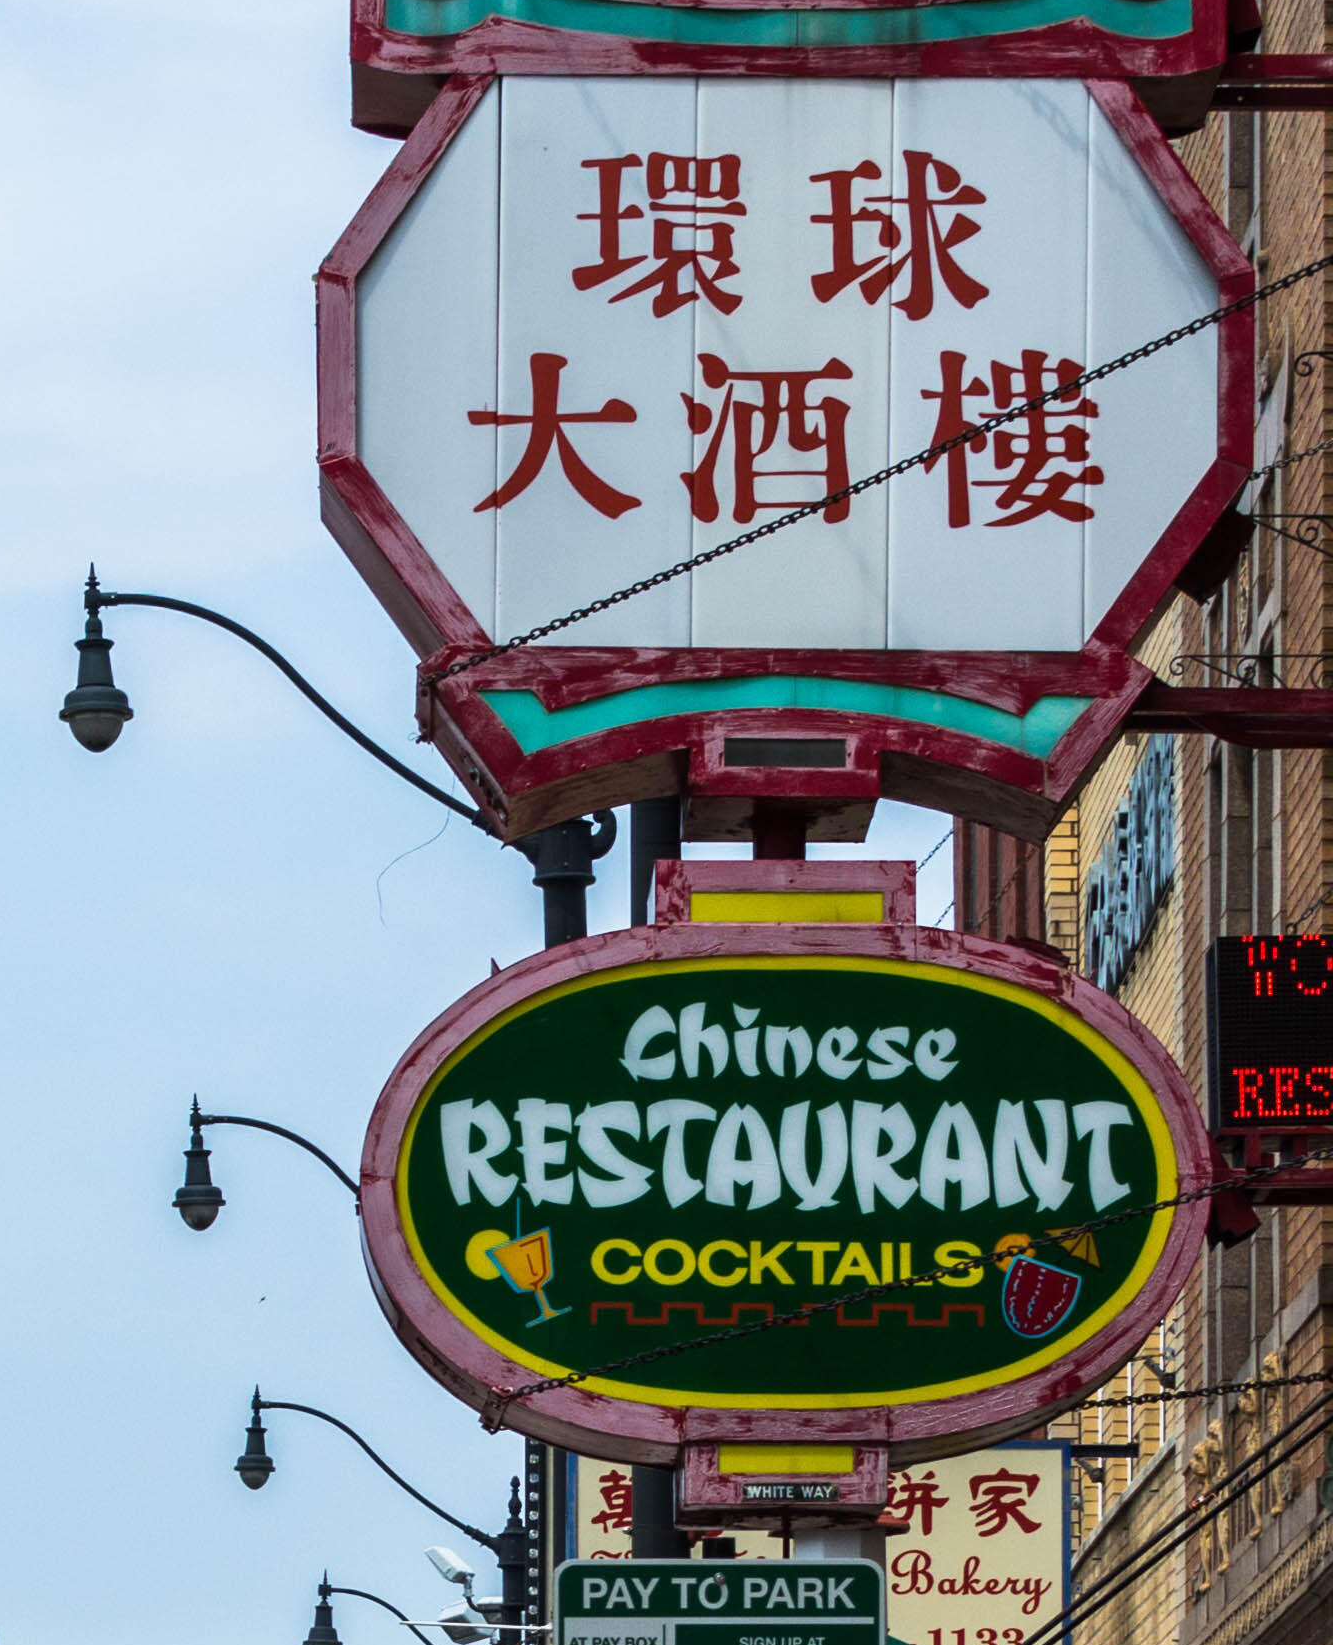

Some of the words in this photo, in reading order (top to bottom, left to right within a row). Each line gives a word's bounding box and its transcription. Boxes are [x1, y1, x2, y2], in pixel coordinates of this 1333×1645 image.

[571, 149, 989, 321] 環球
[466, 349, 1106, 530] 大酒樓
[619, 1001, 961, 1084] Chinese
[438, 1095, 1133, 1215] RESTAURANT
[589, 1238, 984, 1288] COCKTAILS
[747, 1485, 795, 1500] WHITE
[801, 1485, 834, 1501] WAY
[582, 1577, 660, 1610] PAY
[671, 1577, 729, 1610] TO
[742, 1577, 856, 1610] PARK
[891, 1549, 1053, 1615] Bakery
